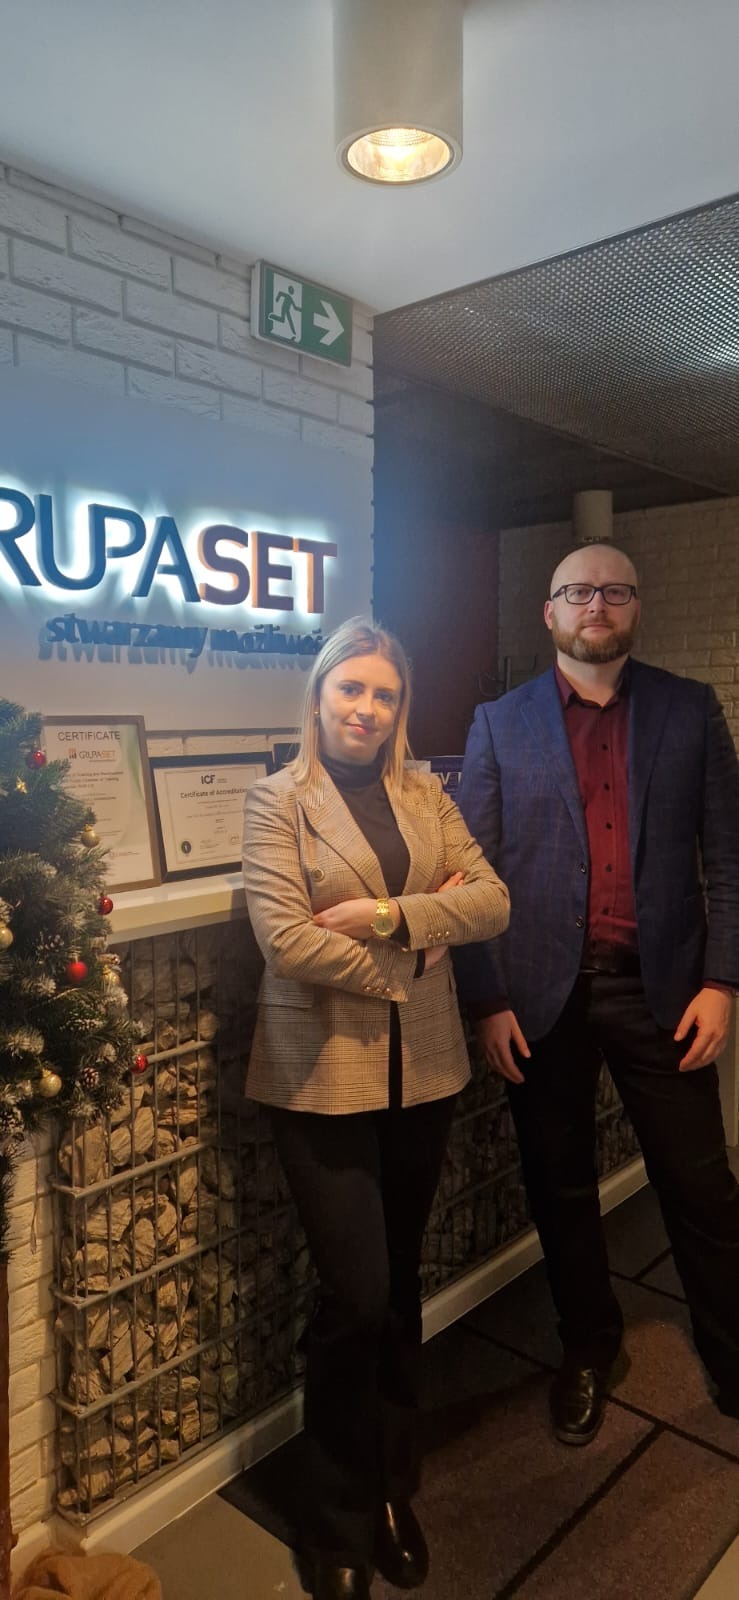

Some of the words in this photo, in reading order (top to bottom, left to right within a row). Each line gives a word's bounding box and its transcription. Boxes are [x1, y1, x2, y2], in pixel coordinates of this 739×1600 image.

[46, 612, 208, 658] stwarzamy
[57, 730, 121, 742] CERTIFICATE
[201, 774, 216, 785] ICF
[180, 791, 209, 799] Certificate
